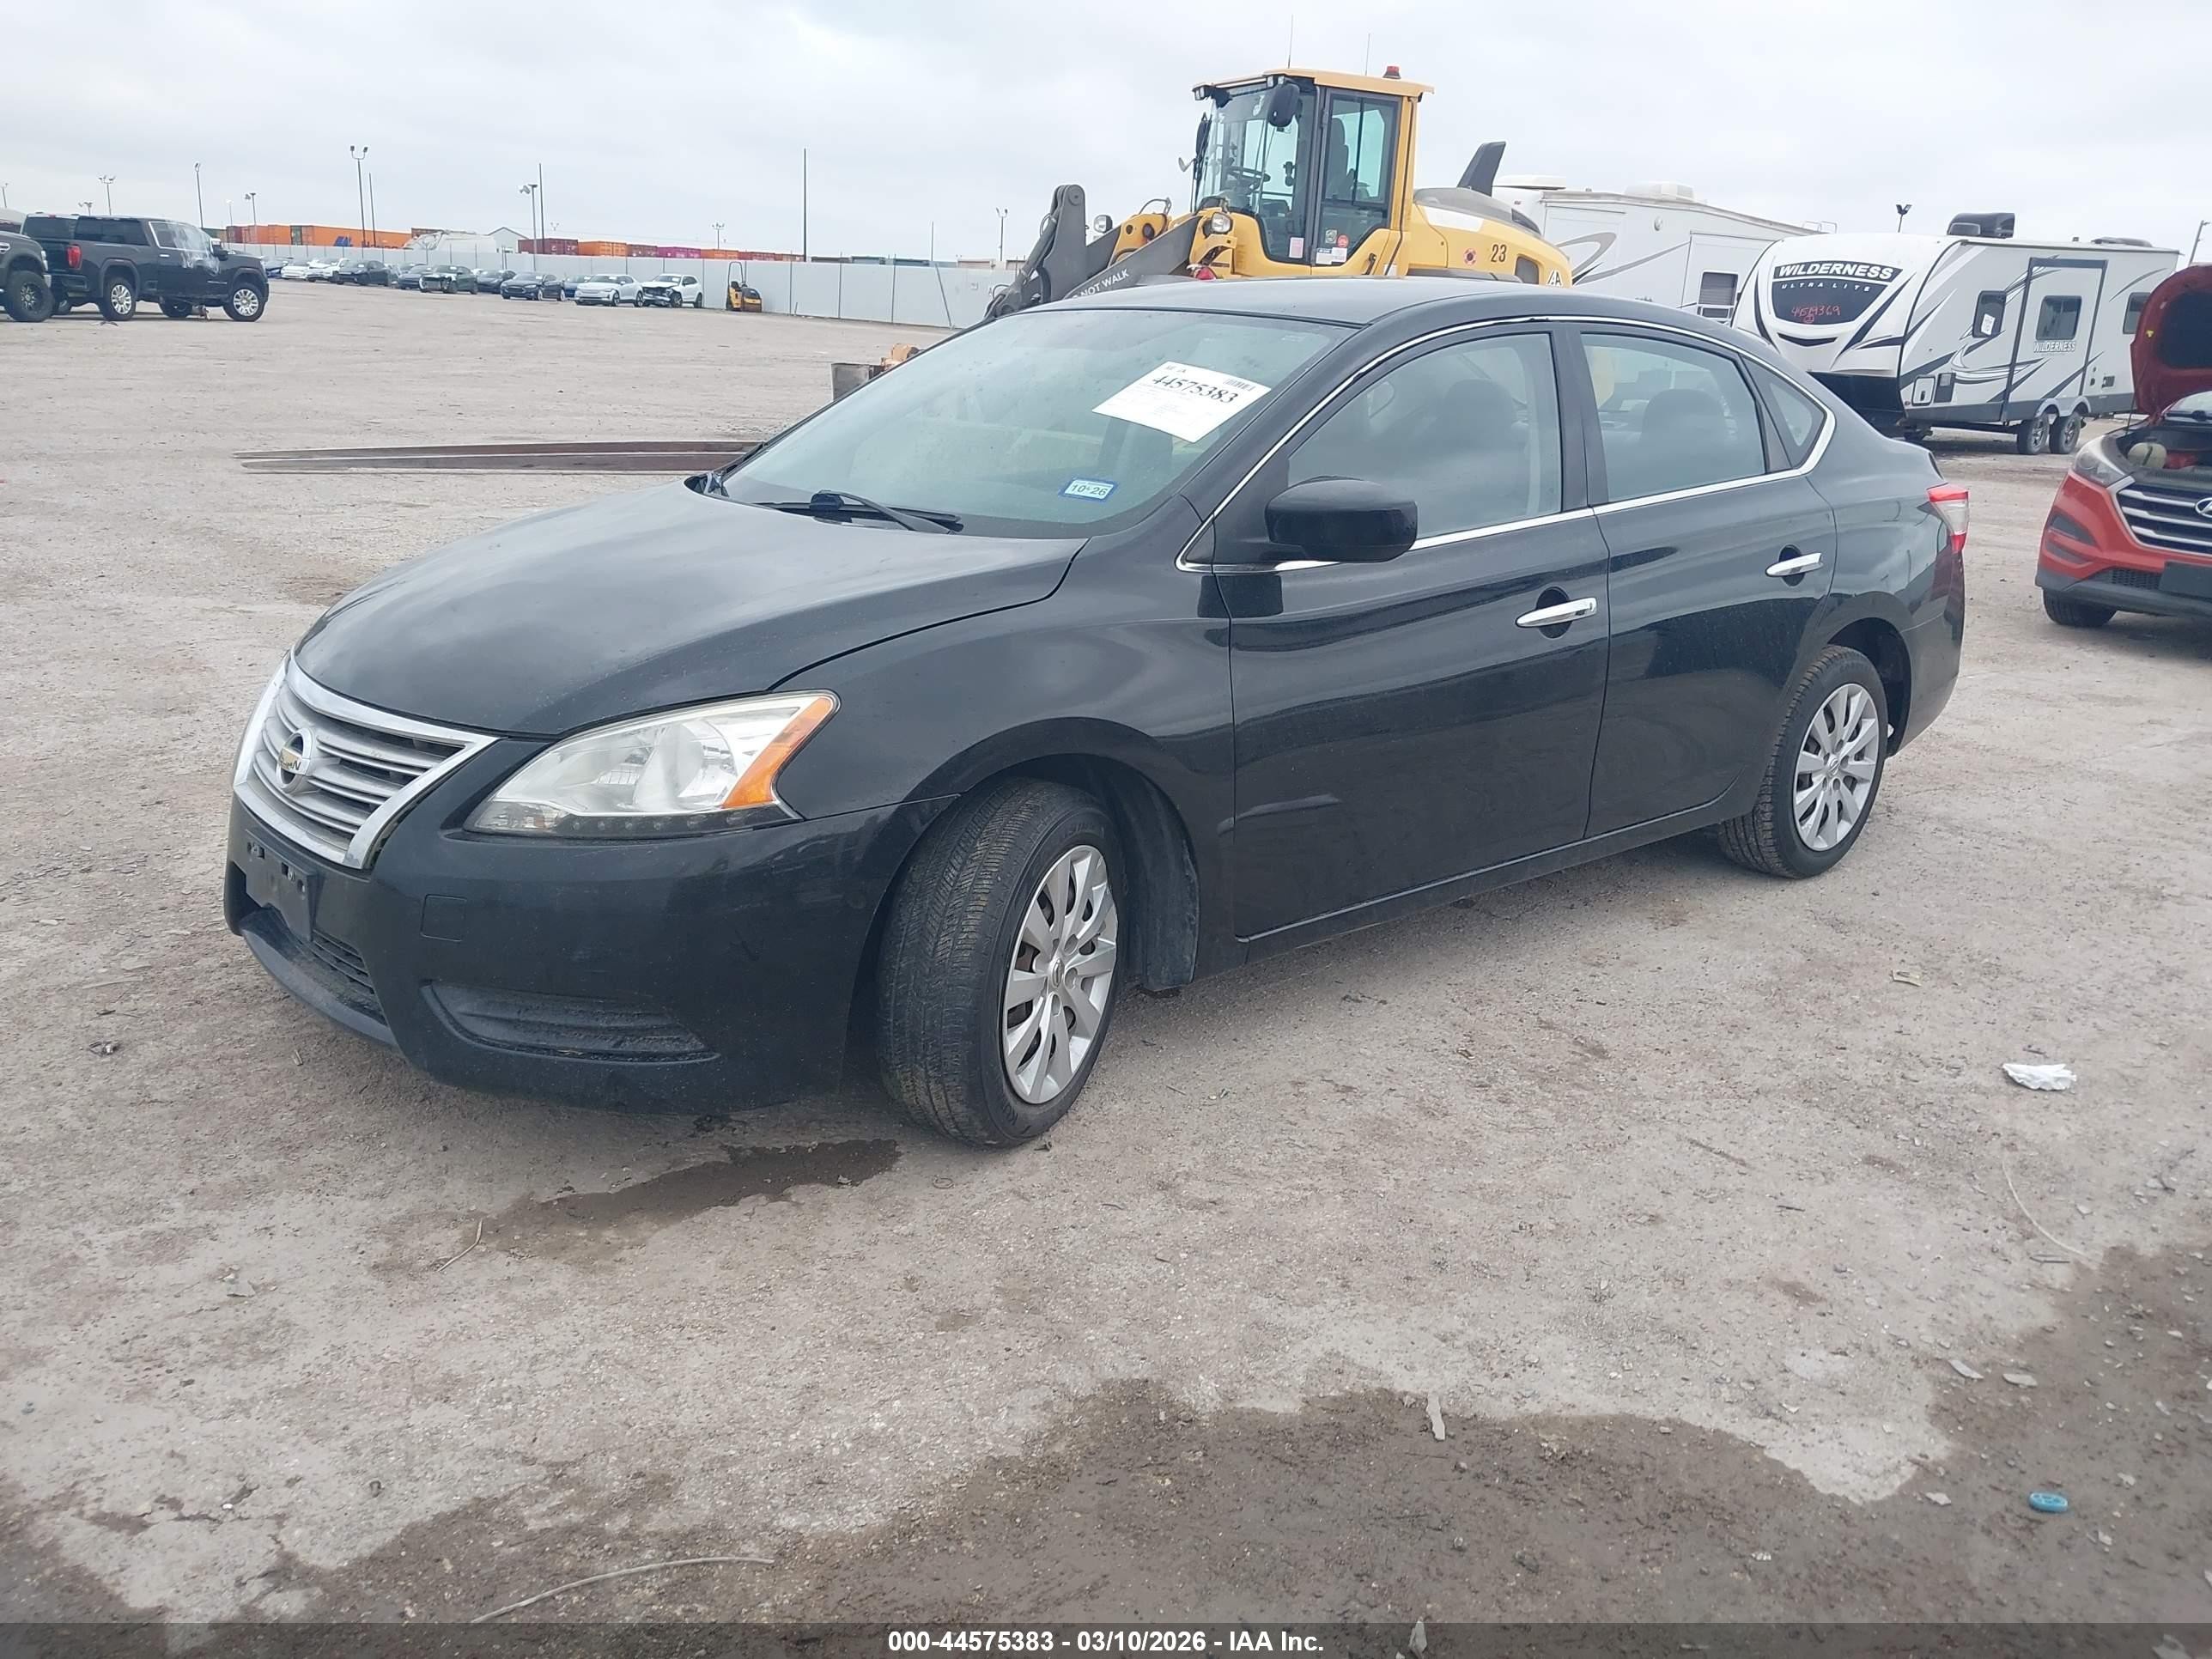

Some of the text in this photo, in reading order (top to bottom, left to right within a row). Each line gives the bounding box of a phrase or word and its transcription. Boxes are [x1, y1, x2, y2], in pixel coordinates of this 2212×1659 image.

[1491, 244, 1507, 262] 23
[1778, 263, 1894, 280] WILDERNESS
[1080, 269, 1129, 297] NOT WALK
[1832, 283, 1871, 292] LITE
[2033, 341, 2075, 353] WILDERNESS
[1152, 375, 1239, 404] 44575383
[1091, 486, 1108, 496] 26
